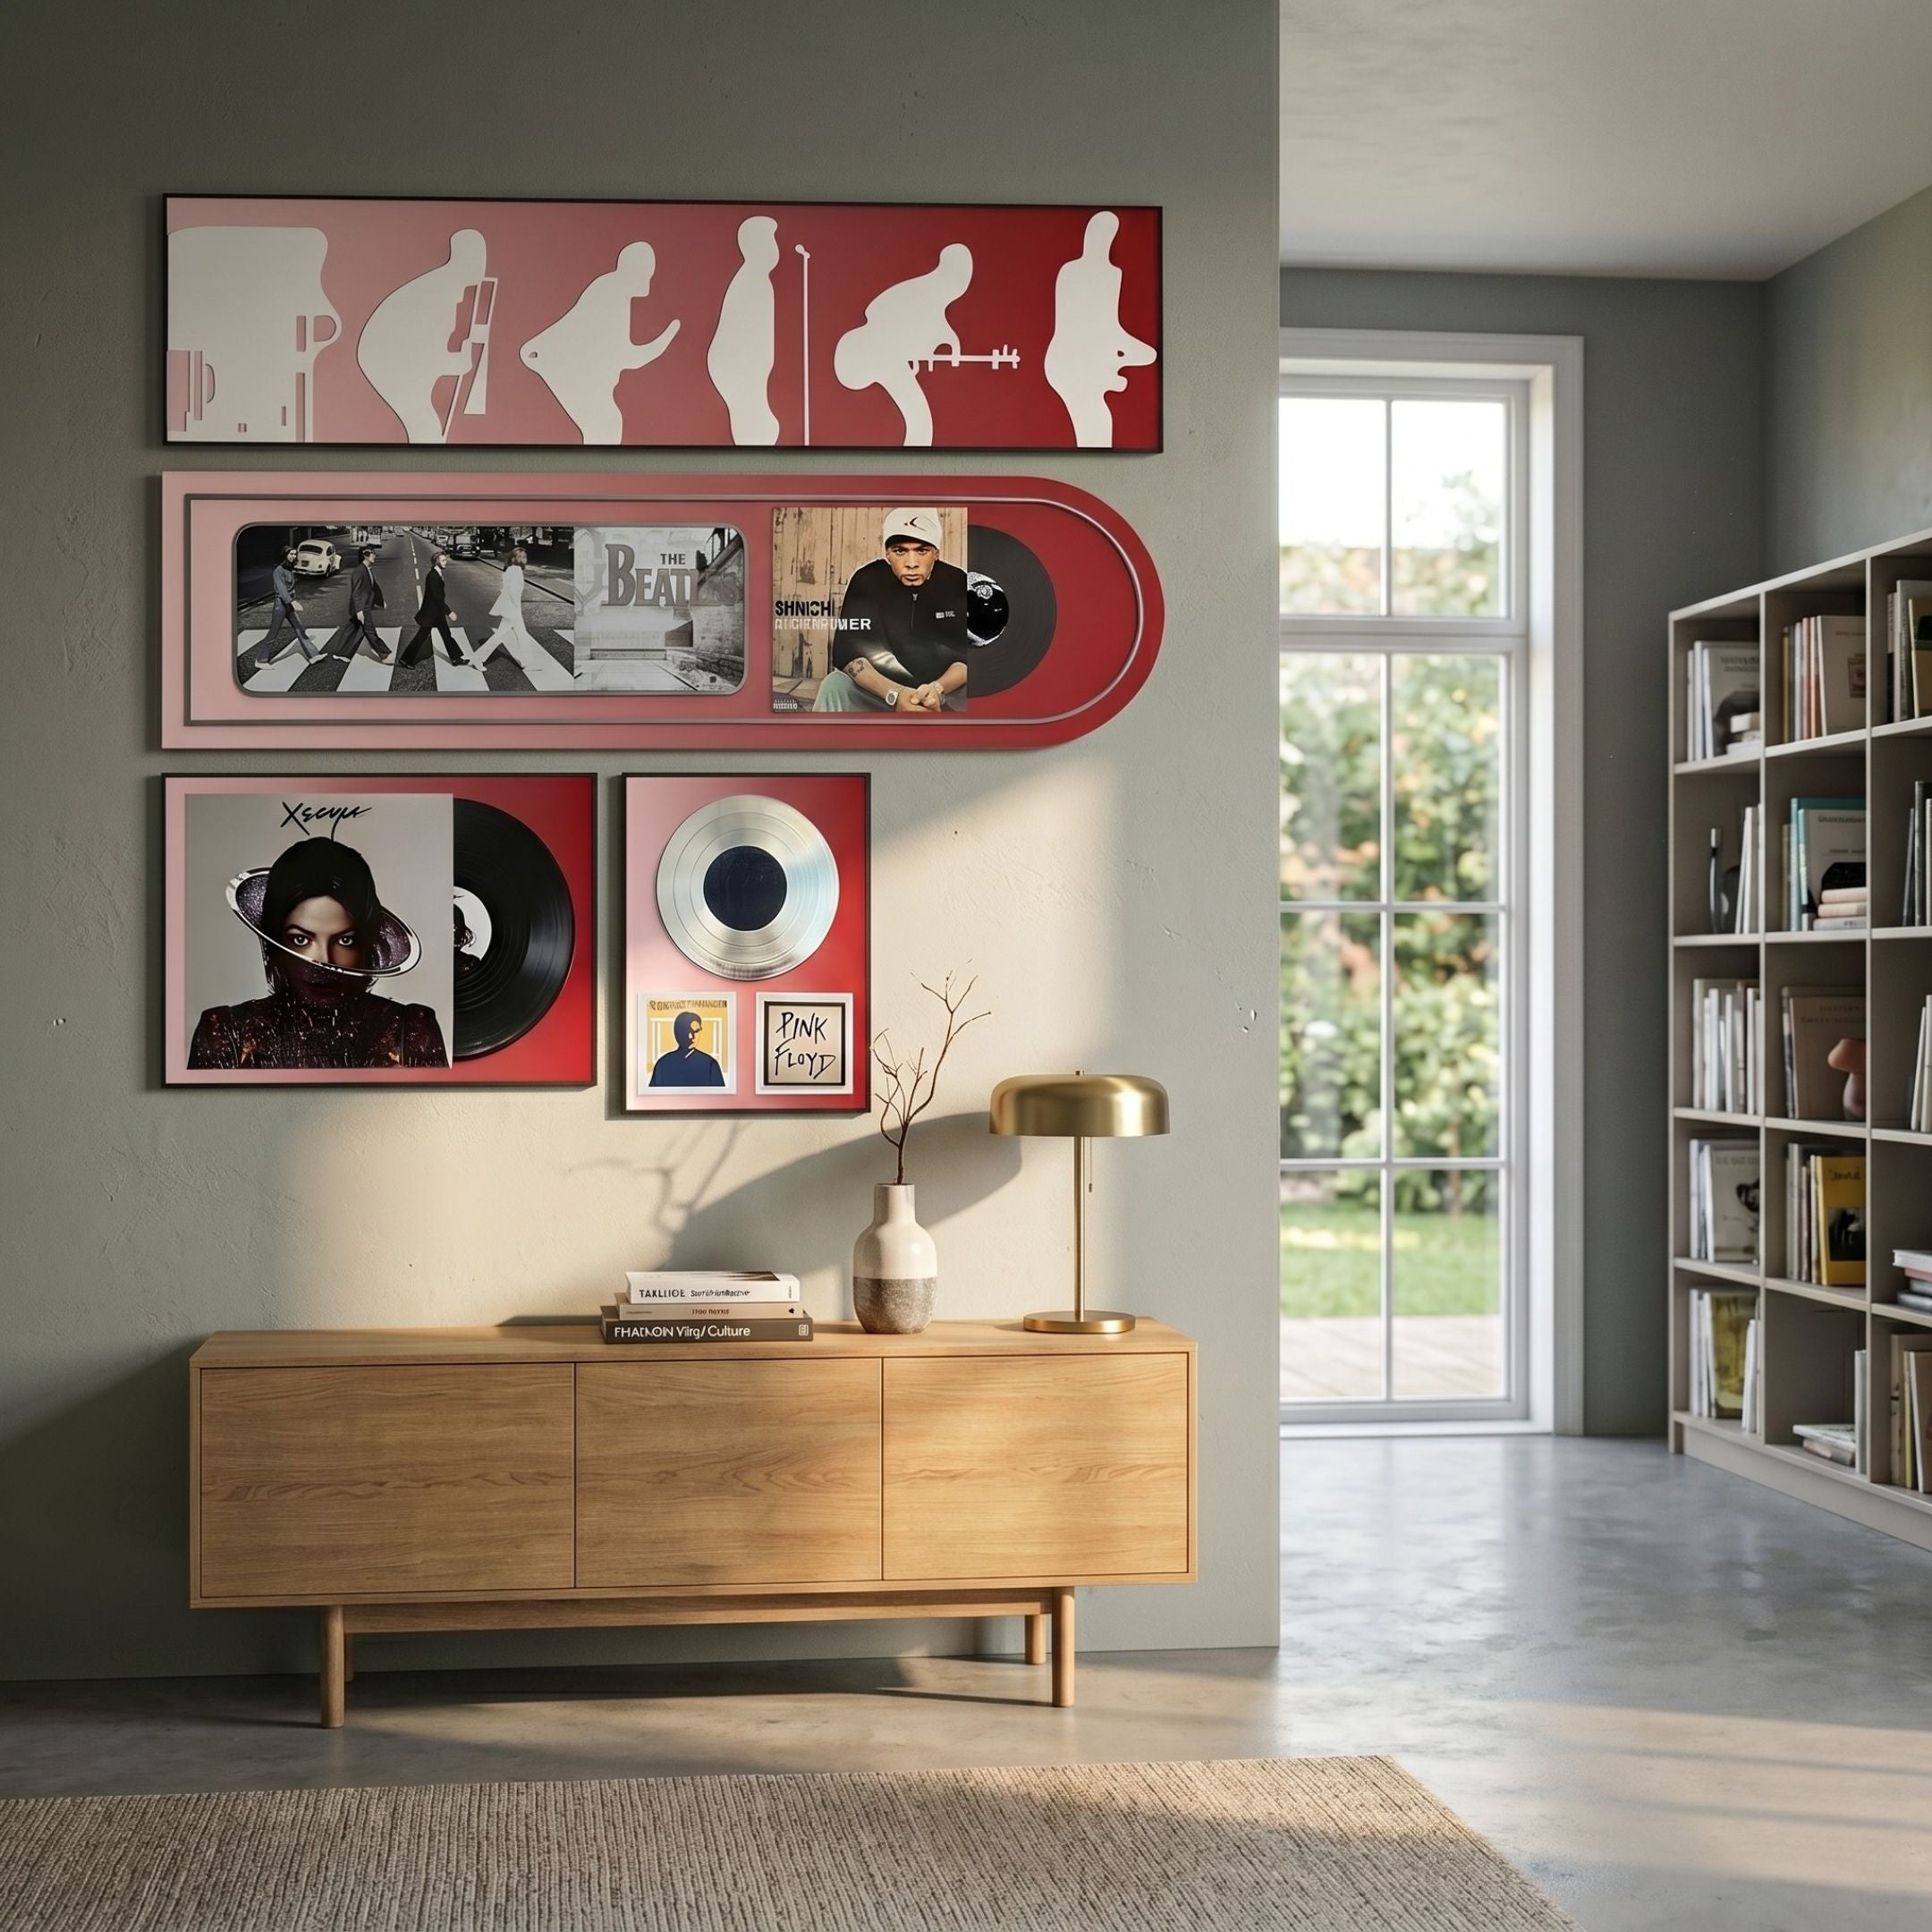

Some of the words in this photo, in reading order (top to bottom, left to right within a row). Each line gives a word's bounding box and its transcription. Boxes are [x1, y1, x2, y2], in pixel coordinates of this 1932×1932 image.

[660, 553, 686, 565] THE
[775, 1012, 828, 1045] PINK
[775, 1038, 836, 1080] FLOYD
[708, 1325, 750, 1337] Culture
